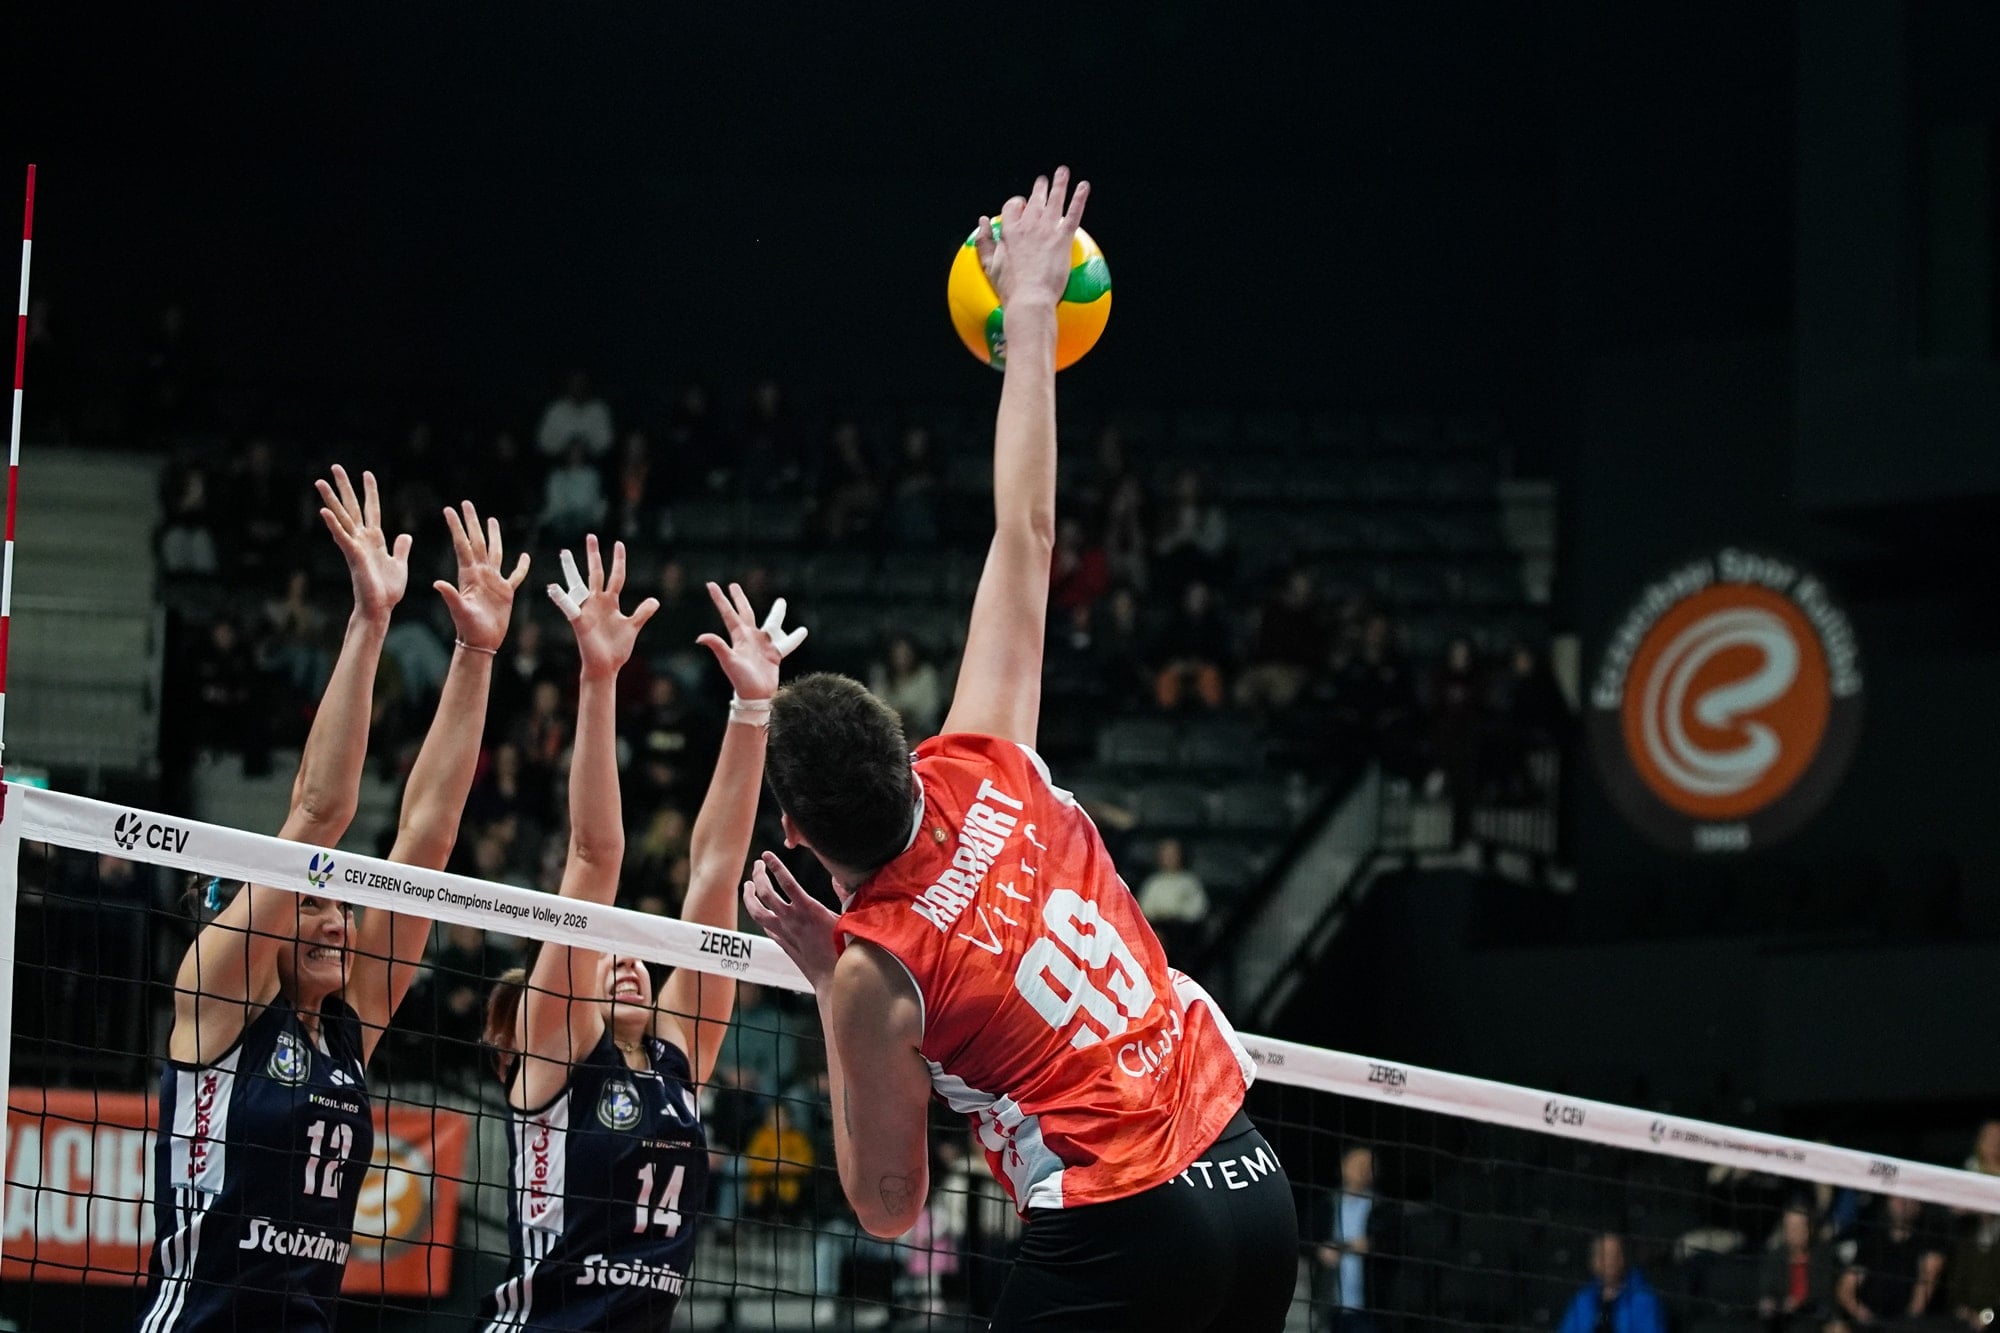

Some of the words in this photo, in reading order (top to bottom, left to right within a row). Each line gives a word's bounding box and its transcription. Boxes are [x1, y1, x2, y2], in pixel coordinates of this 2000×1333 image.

[145, 823, 190, 854] CEV
[344, 868, 367, 884] CEV
[367, 873, 402, 892] ZEREN
[403, 881, 435, 902] Group
[437, 888, 493, 911] Champions
[494, 898, 530, 918] League
[532, 906, 562, 927] Volley
[563, 912, 588, 929] 2026
[699, 929, 752, 960] ZEREN
[720, 958, 750, 972] GROUP
[1015, 889, 1155, 1049] 99
[1368, 1063, 1408, 1088] ZEREN
[318, 1095, 360, 1114] KOILKOS
[304, 1120, 354, 1199] 12
[5, 1124, 158, 1246] ACIB
[634, 1162, 686, 1239] 14
[576, 1254, 684, 1297] Stoixim
